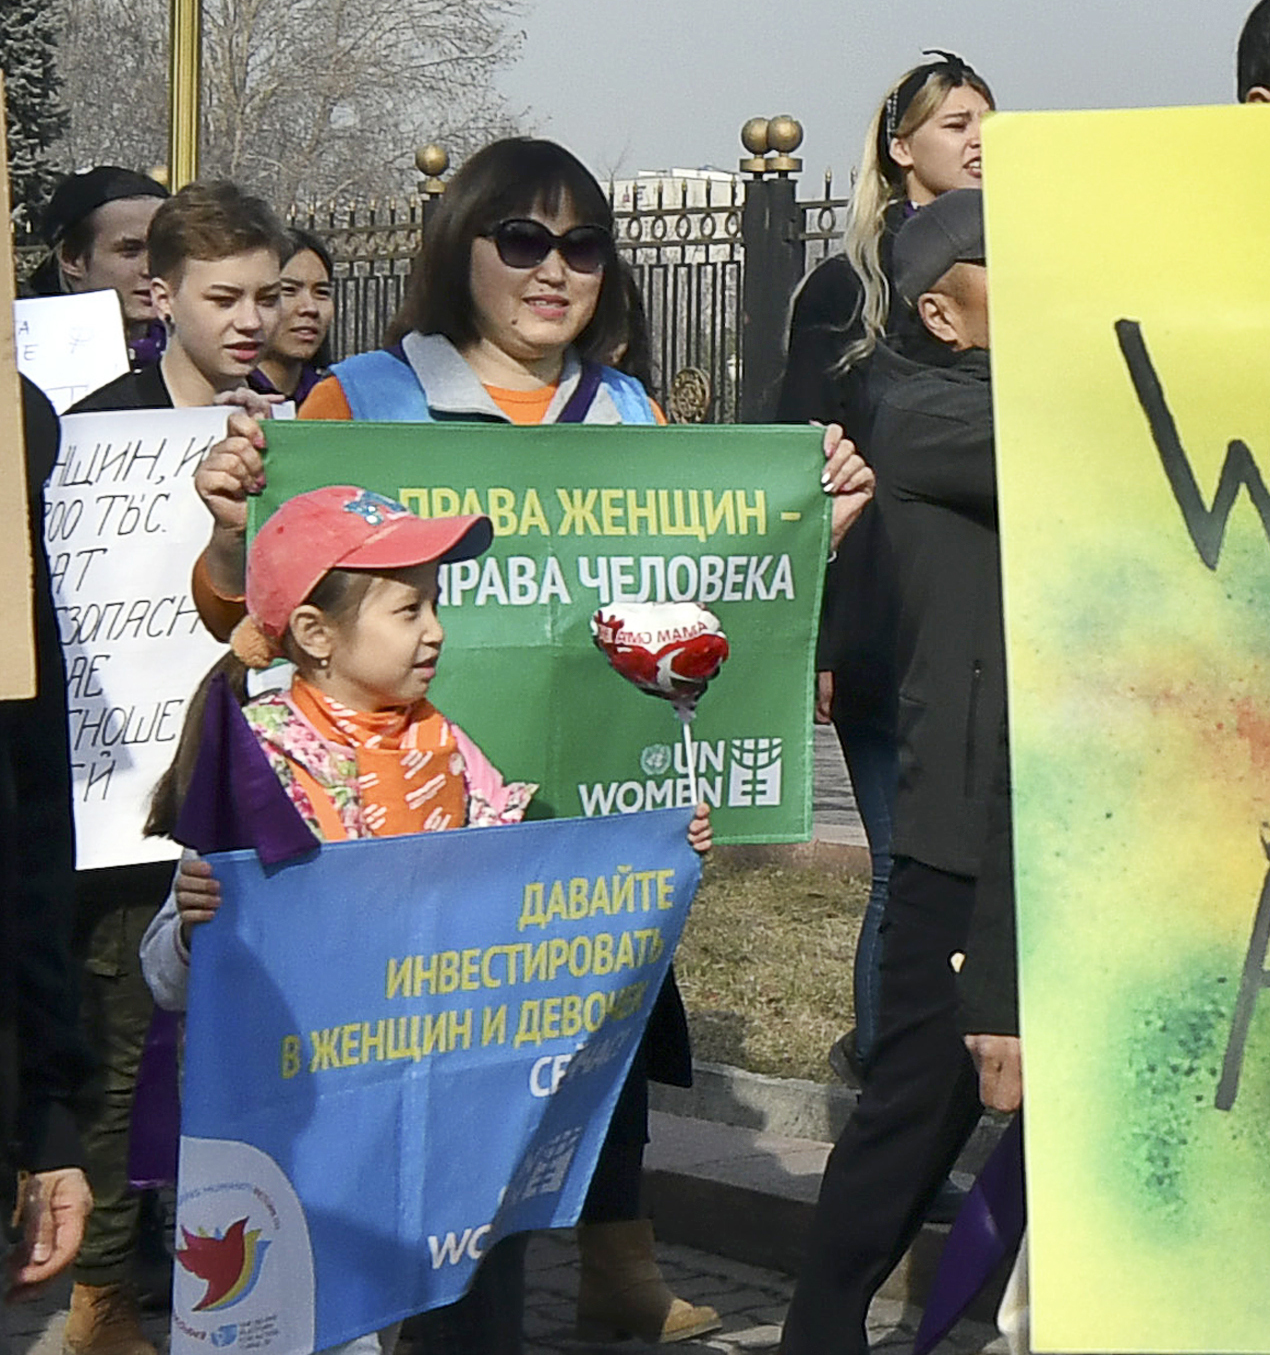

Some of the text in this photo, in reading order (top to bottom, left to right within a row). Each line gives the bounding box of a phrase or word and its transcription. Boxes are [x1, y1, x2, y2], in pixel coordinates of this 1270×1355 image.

[398, 487, 551, 537] ПРАВА
[556, 487, 766, 542] ЖЕНЩИН
[579, 553, 794, 605] ЧЕЛОВЕКА
[674, 740, 726, 774] UN
[577, 775, 723, 817] WOMEN
[518, 865, 676, 932] ДАВАЙТЕ
[386, 926, 665, 1000] ИНВЕСТИРОВАТЬ
[280, 1034, 301, 1080] В
[309, 1009, 472, 1074] ЖЕНЩИН
[481, 1004, 507, 1048] И
